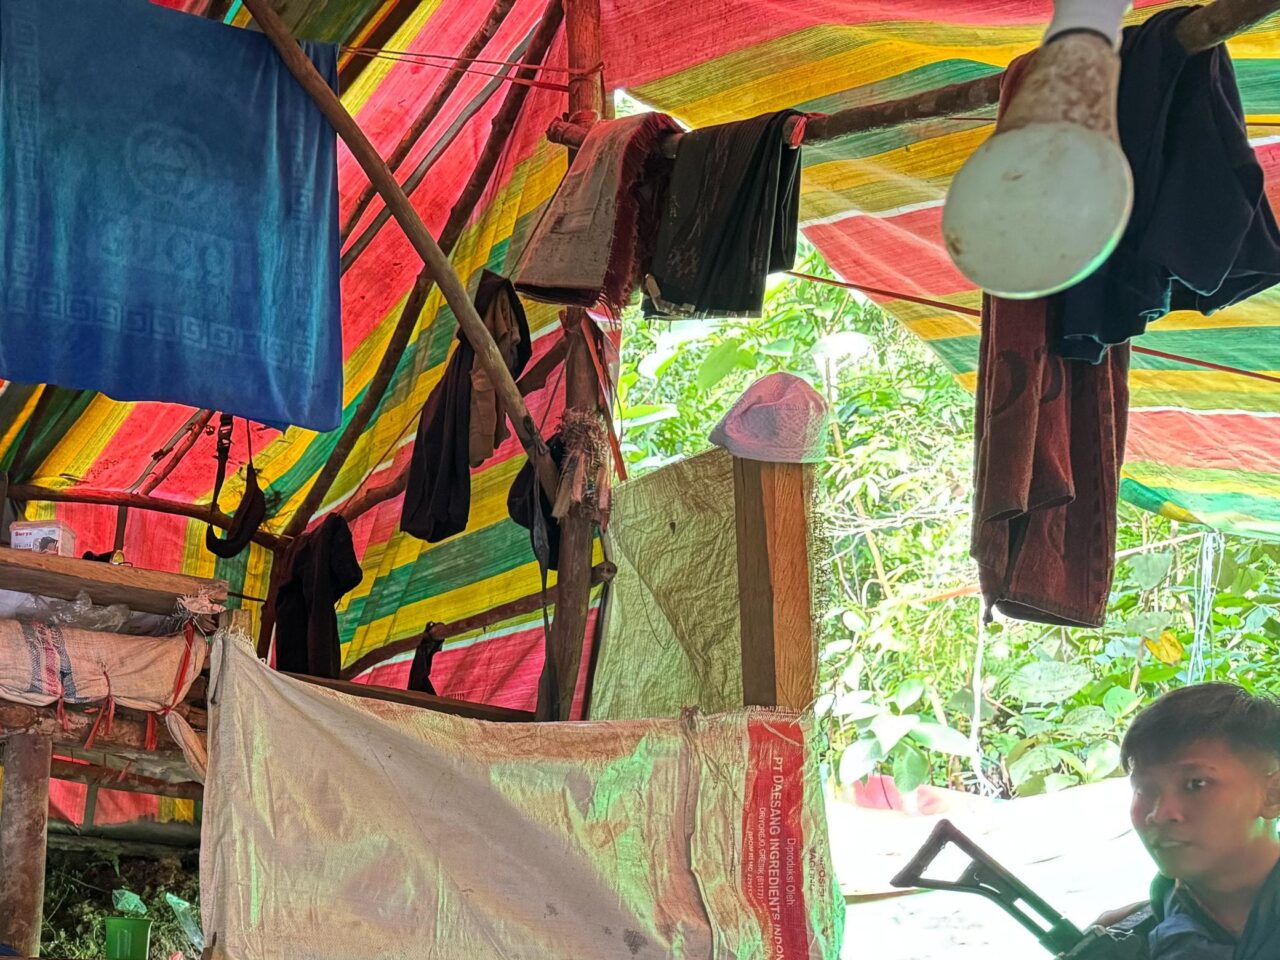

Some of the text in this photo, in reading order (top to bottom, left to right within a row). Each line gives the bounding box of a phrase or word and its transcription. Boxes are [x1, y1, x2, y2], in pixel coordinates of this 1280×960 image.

[772, 756, 783, 773] PT
[769, 775, 783, 835] DAESANG
[768, 839, 781, 920] INGREDIENTS
[785, 838, 797, 880] Diproduksi
